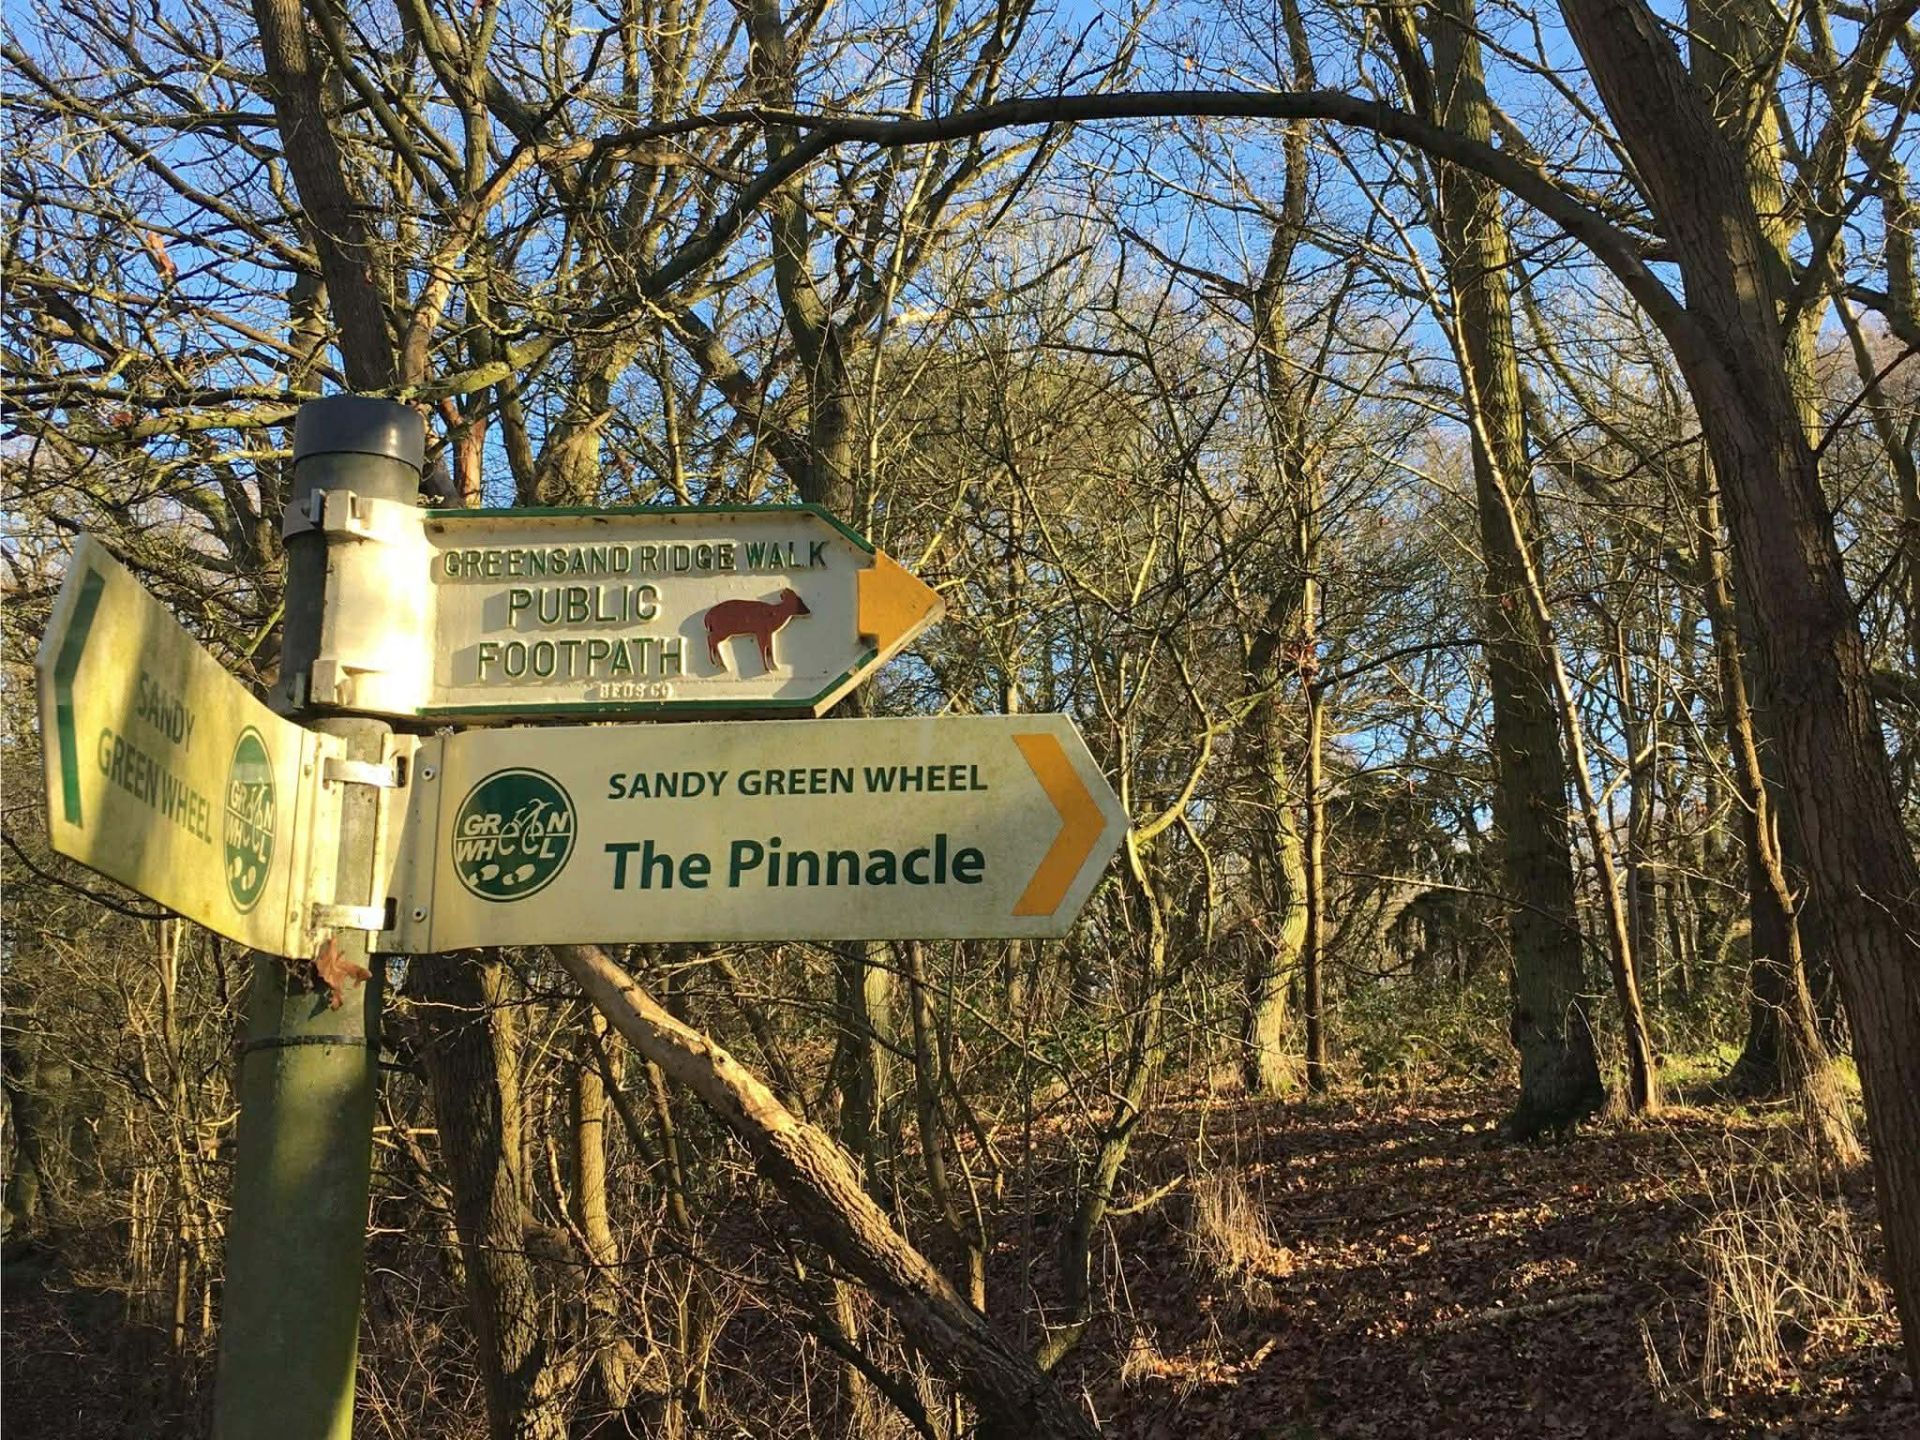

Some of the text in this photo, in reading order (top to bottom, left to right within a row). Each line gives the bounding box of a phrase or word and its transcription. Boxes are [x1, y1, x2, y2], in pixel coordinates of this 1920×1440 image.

[443, 540, 829, 578] GREENSAND RIDGE WALK
[508, 584, 662, 628] PUBLIC
[478, 637, 686, 679] FOOTPATH
[137, 670, 196, 753] SANDY
[97, 727, 212, 845] GREEN WHEEL
[607, 764, 988, 800] SANDY GREEN WHEEL
[604, 833, 985, 890] The Pinnacle
